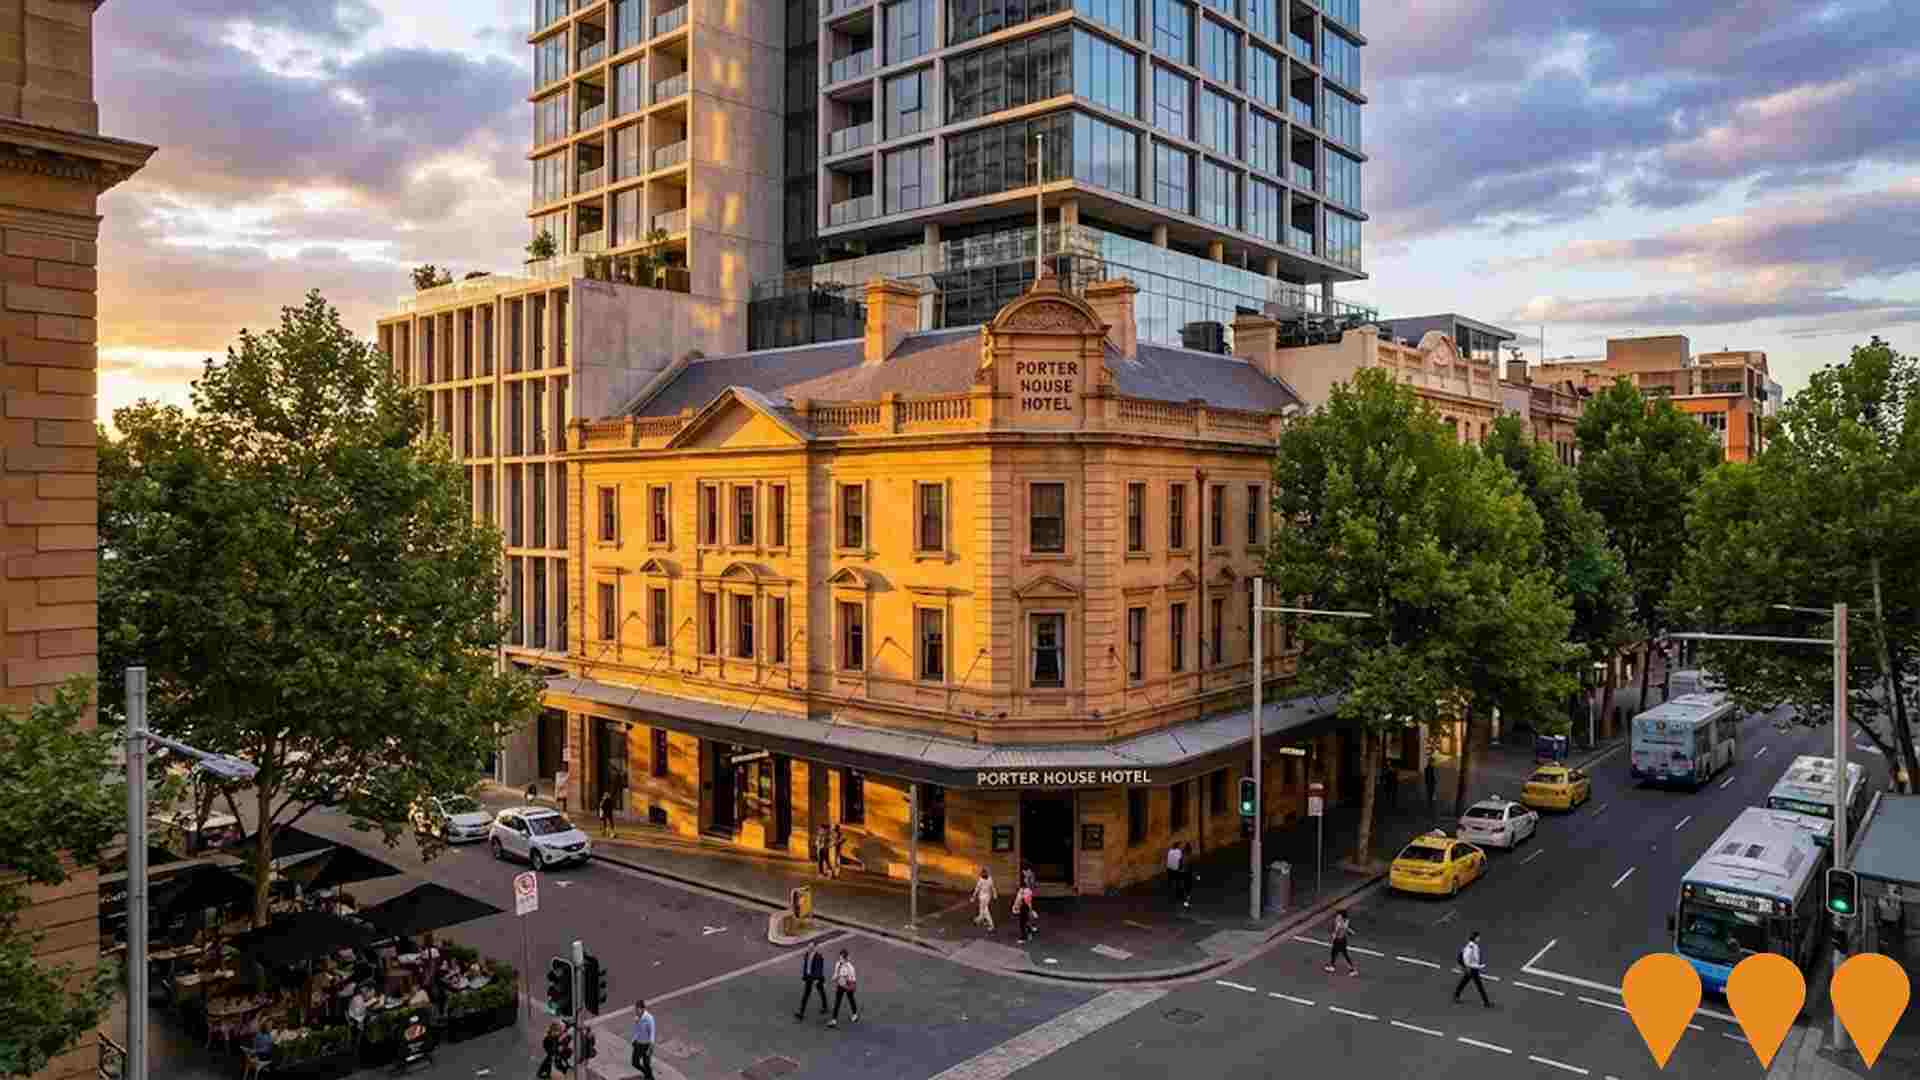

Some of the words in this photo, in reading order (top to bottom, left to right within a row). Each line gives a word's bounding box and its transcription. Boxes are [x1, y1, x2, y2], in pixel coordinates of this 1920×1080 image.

[1016, 361, 1078, 375] PORTER
[1022, 397, 1073, 411] HOTEL
[976, 771, 1039, 785] PORTER
[1044, 771, 1097, 784] HOUSE
[1101, 769, 1152, 783] HOTEL
